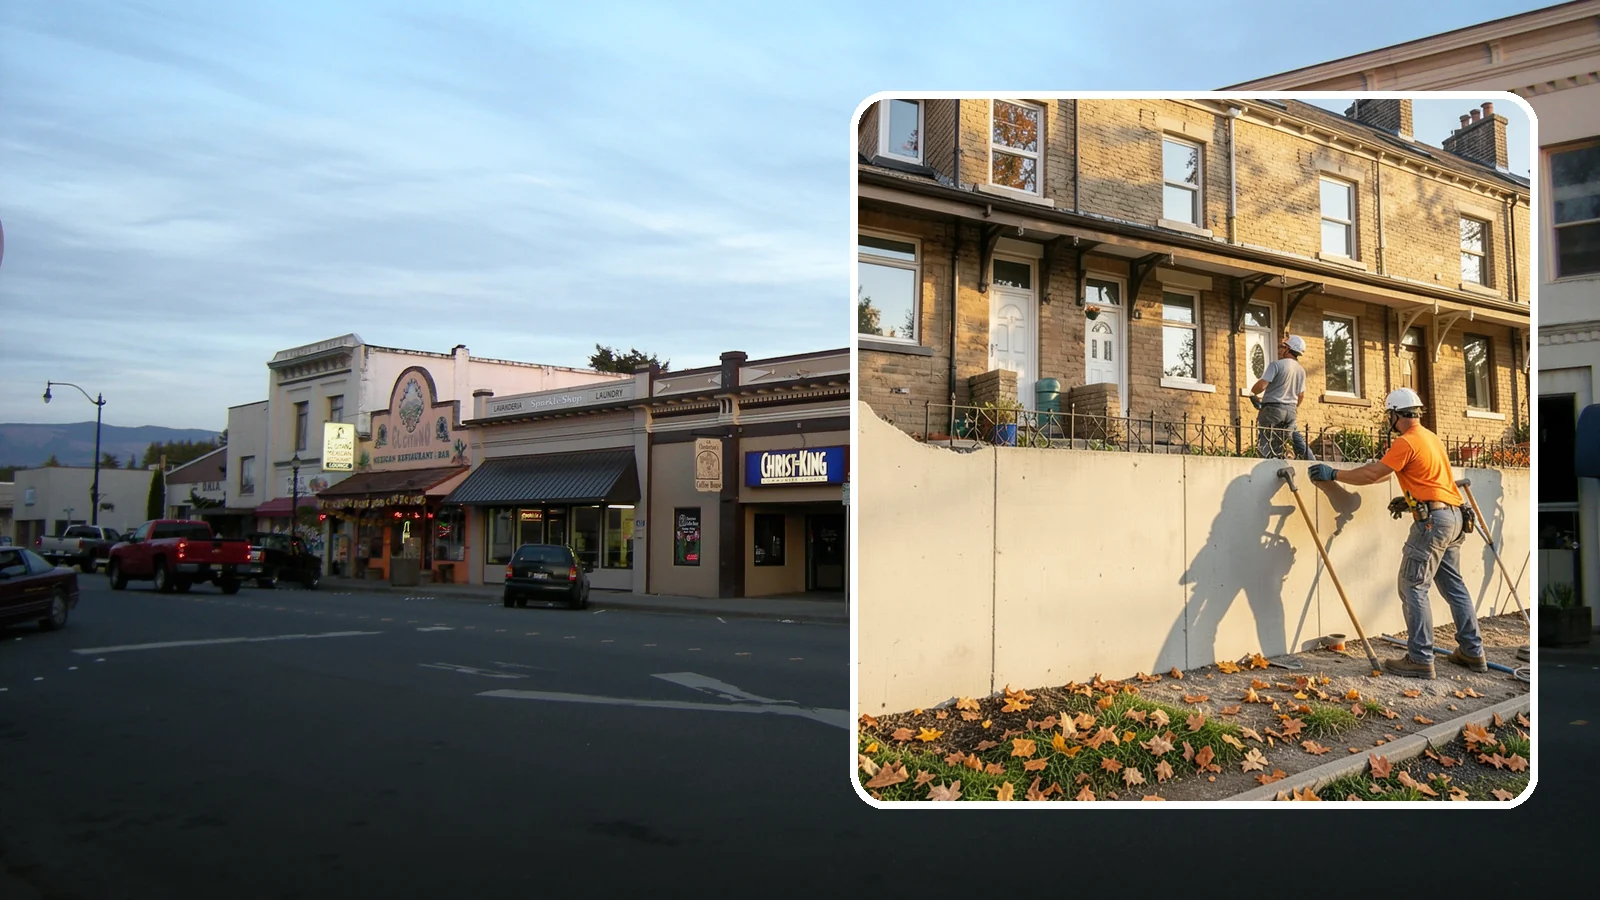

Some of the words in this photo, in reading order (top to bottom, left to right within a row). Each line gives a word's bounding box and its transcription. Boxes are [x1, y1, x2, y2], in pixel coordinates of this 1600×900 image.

[595, 389, 623, 400] LAUNDRY
[493, 402, 523, 412] LAVANDERIA
[530, 397, 561, 410] Sparkle
[562, 394, 582, 406] Shop
[374, 454, 397, 464] MEXICAN
[397, 451, 433, 463] RESTAURANT
[438, 450, 450, 459] BAR
[761, 451, 797, 478] CHRIST
[799, 450, 827, 476] KING
